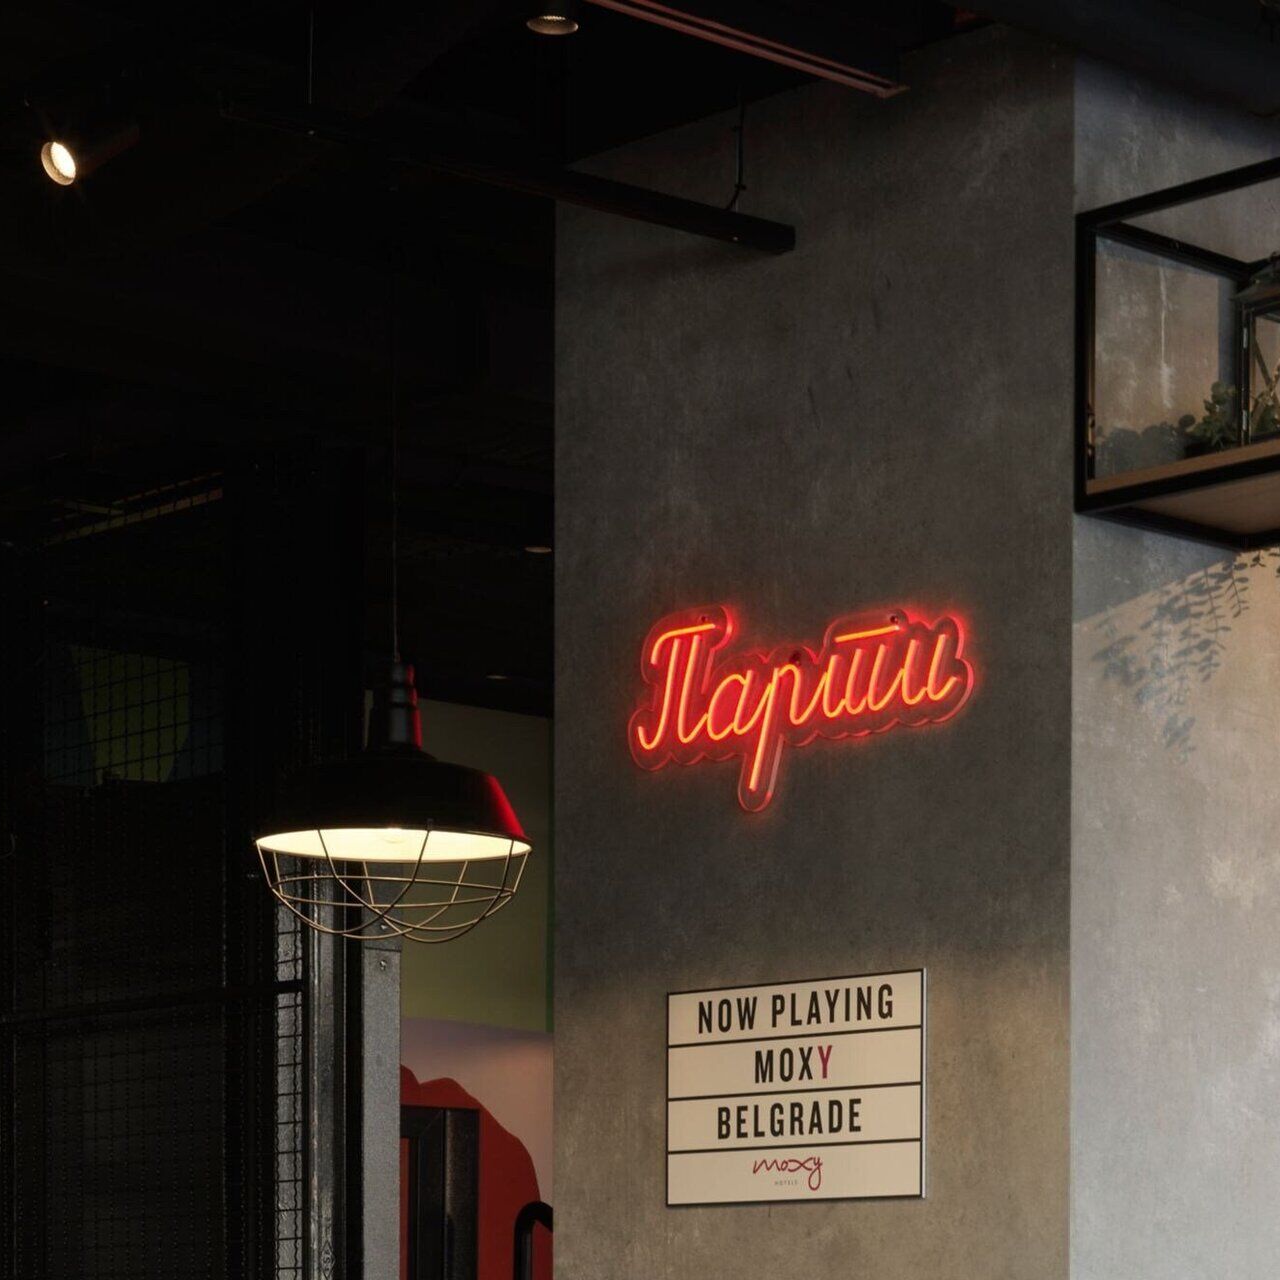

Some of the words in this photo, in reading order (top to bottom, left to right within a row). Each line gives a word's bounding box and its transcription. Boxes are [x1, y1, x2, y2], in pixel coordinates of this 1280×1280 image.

[697, 996, 758, 1035] NOW
[770, 984, 896, 1028] PLAYING
[753, 1045, 833, 1085] MOXY
[716, 1097, 863, 1140] BELGRADE
[752, 1155, 823, 1191] moxy
